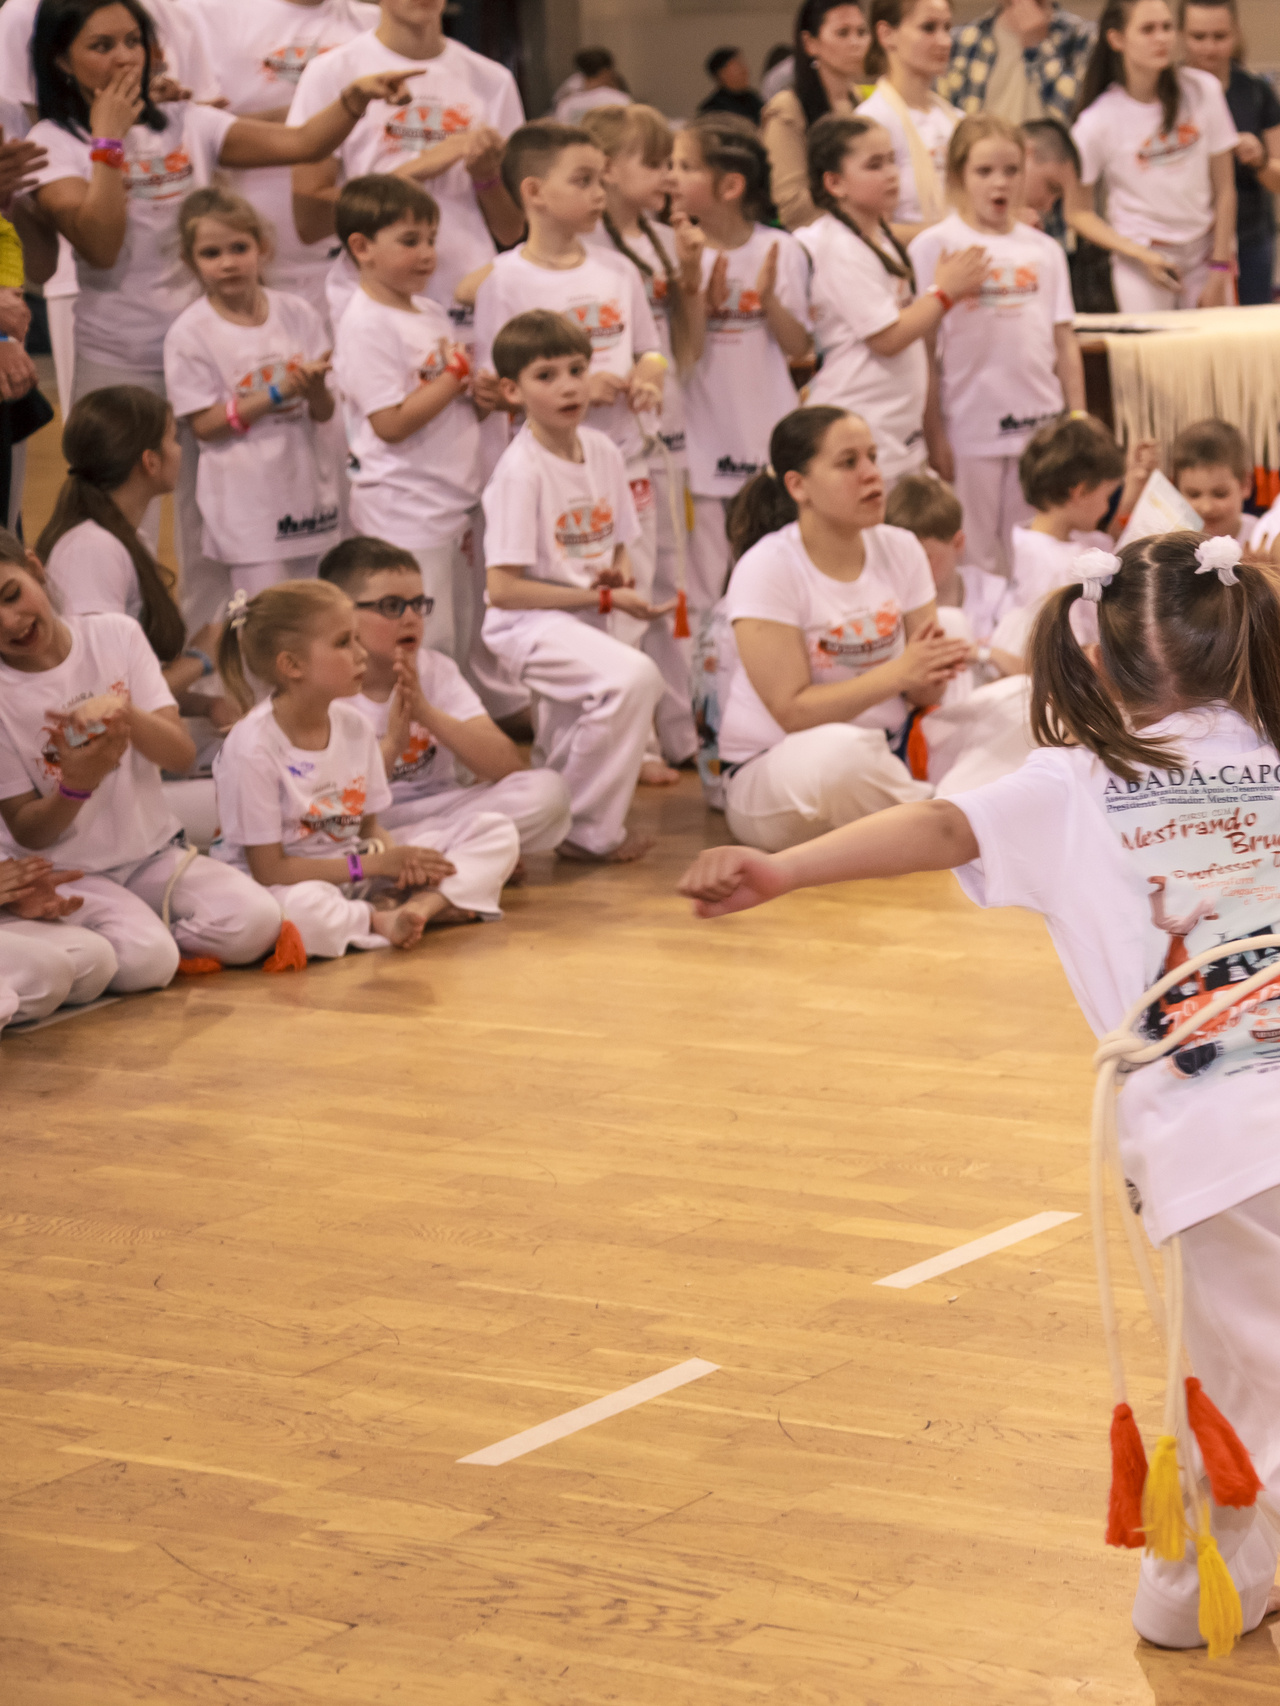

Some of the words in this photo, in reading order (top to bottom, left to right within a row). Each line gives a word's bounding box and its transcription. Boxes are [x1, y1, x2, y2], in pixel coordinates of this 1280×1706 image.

[1151, 786, 1188, 797] Brasileira
[1190, 786, 1199, 794] de
[1106, 800, 1157, 813] Presidente
[1207, 794, 1239, 803] Mestre
[1240, 793, 1274, 802] Camisa
[1171, 858, 1264, 880] Professor
